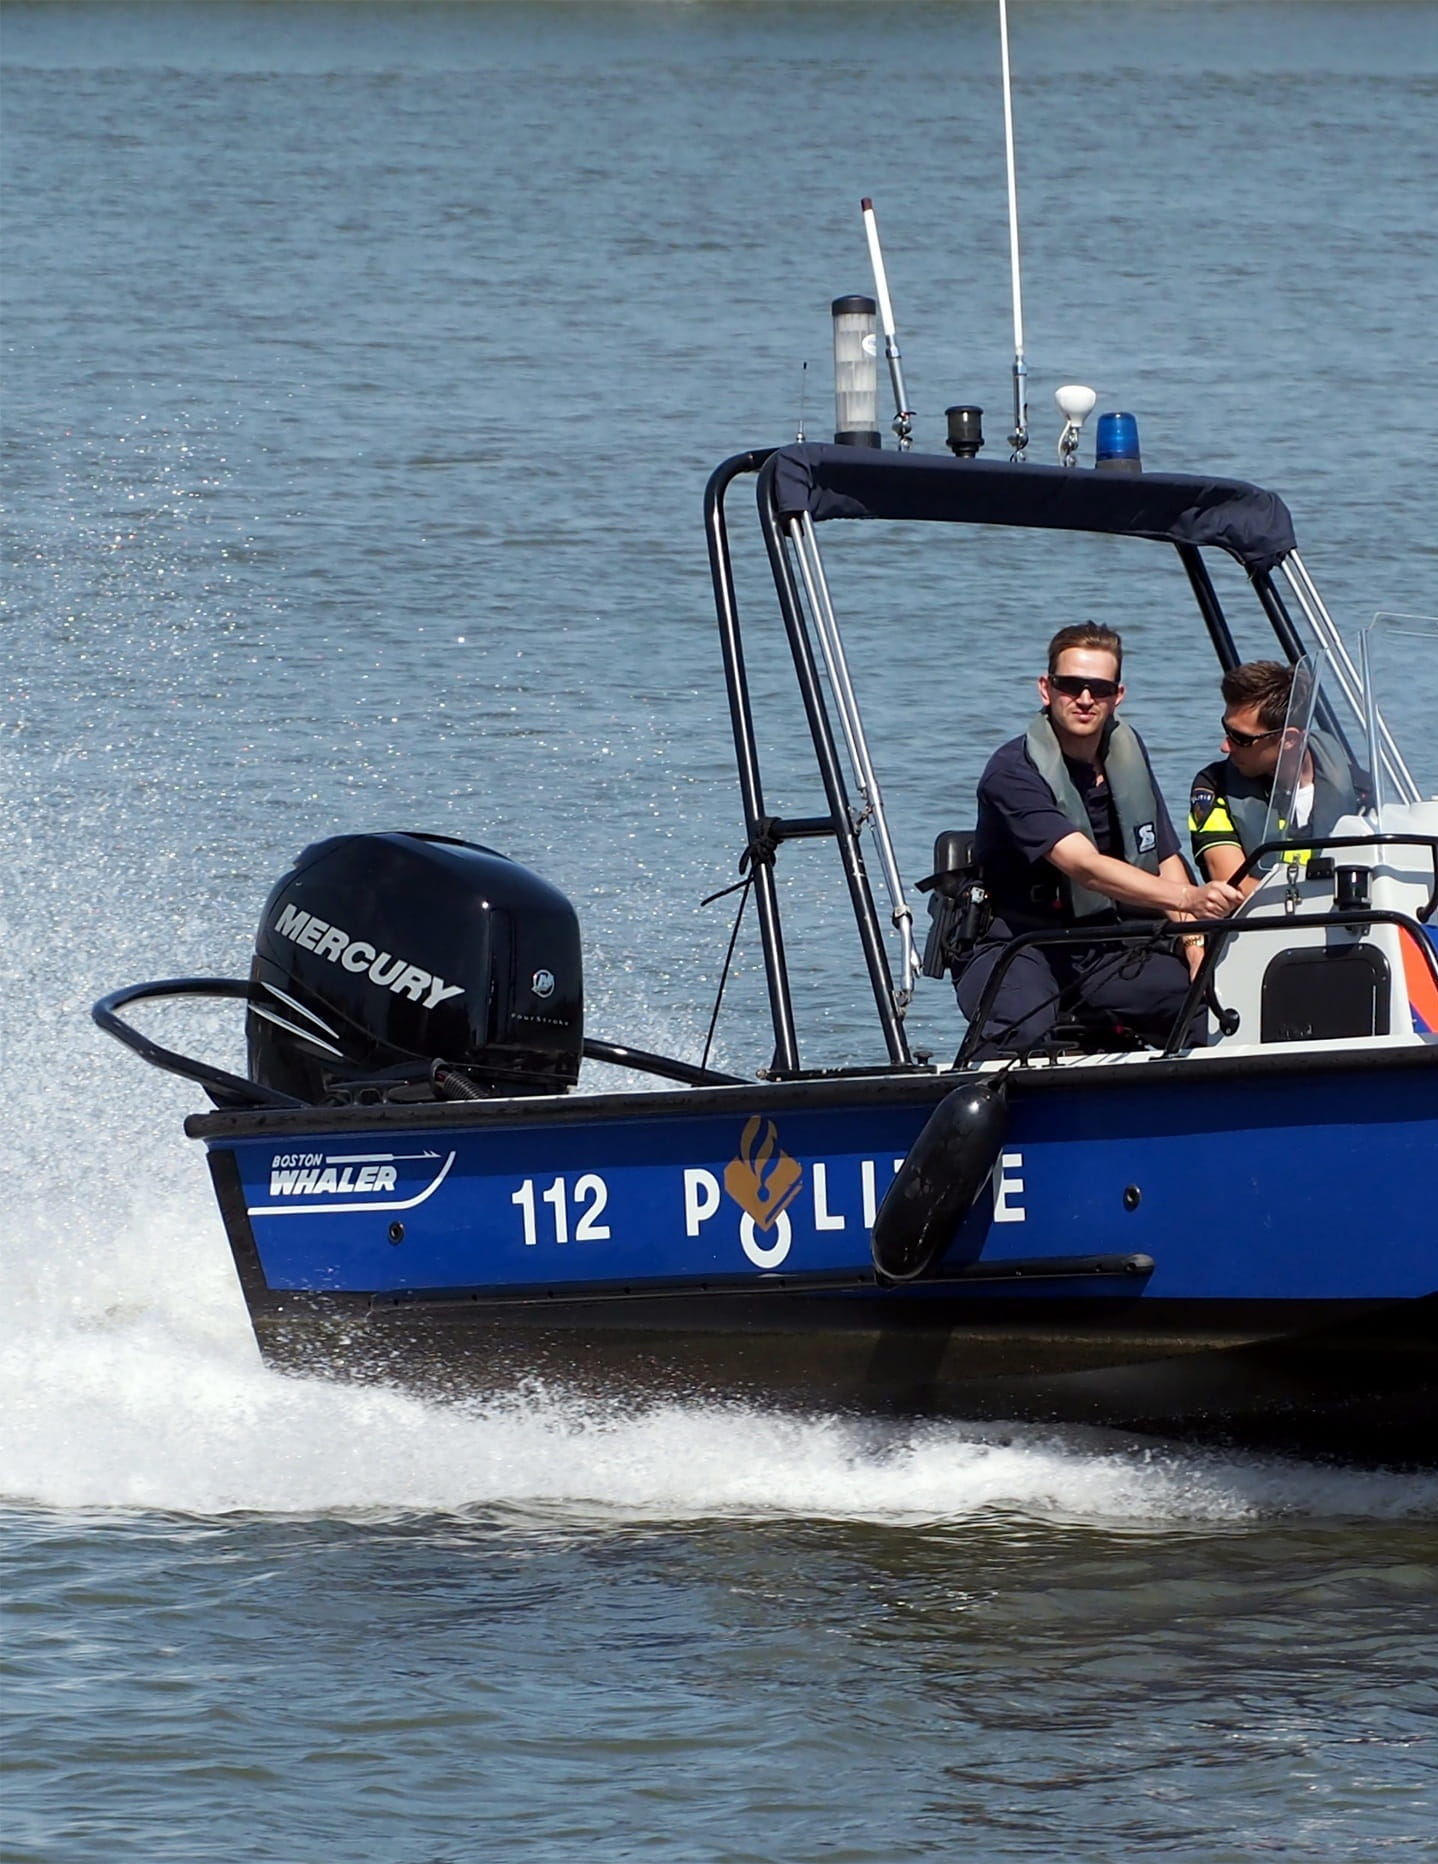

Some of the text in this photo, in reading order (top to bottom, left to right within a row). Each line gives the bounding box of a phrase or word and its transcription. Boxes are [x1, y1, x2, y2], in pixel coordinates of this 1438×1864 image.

[274, 903, 466, 1009] MERCURY
[269, 1165, 398, 1196] WHALER
[272, 1153, 323, 1168] BOSTON
[512, 1173, 611, 1245] 112
[683, 1153, 1026, 1269] POLIE
